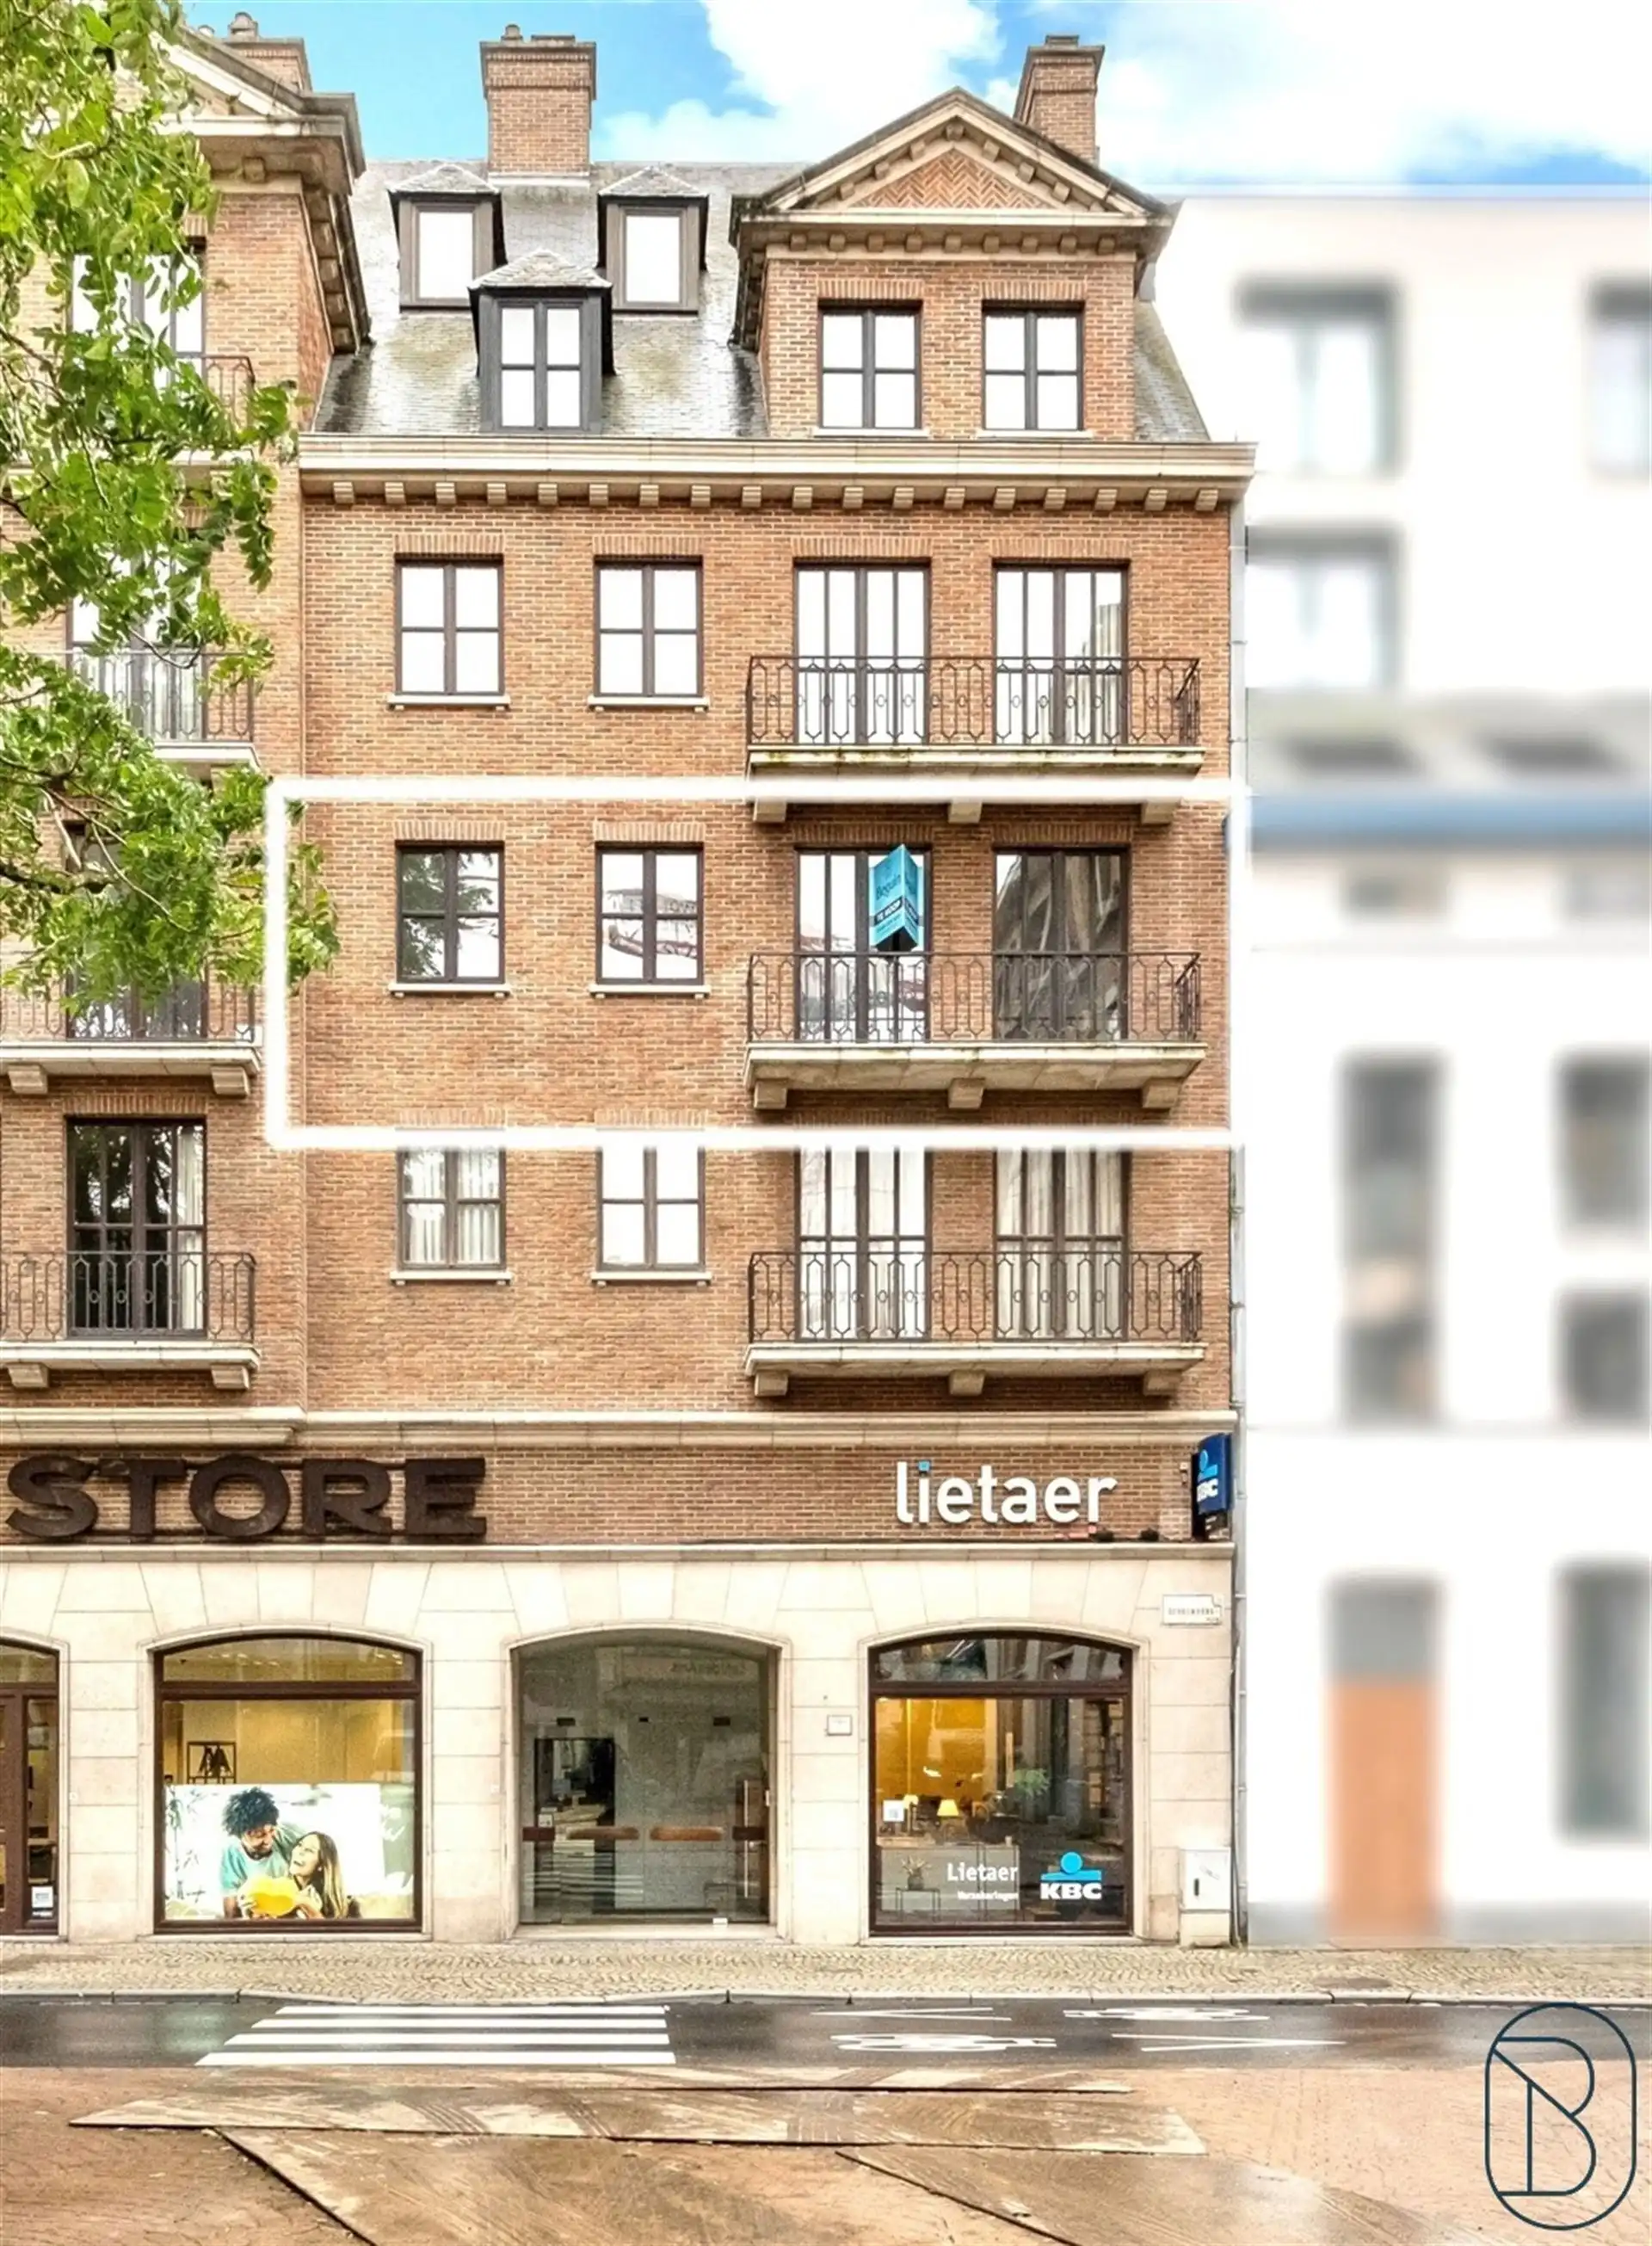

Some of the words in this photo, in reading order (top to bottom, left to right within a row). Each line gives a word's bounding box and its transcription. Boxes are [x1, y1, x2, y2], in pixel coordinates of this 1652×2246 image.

[4, 1454, 487, 1539] STORE
[897, 1460, 1118, 1524] lietaer
[947, 1862, 1018, 1882] Lietaer
[1040, 1882, 1102, 1900] KBC
